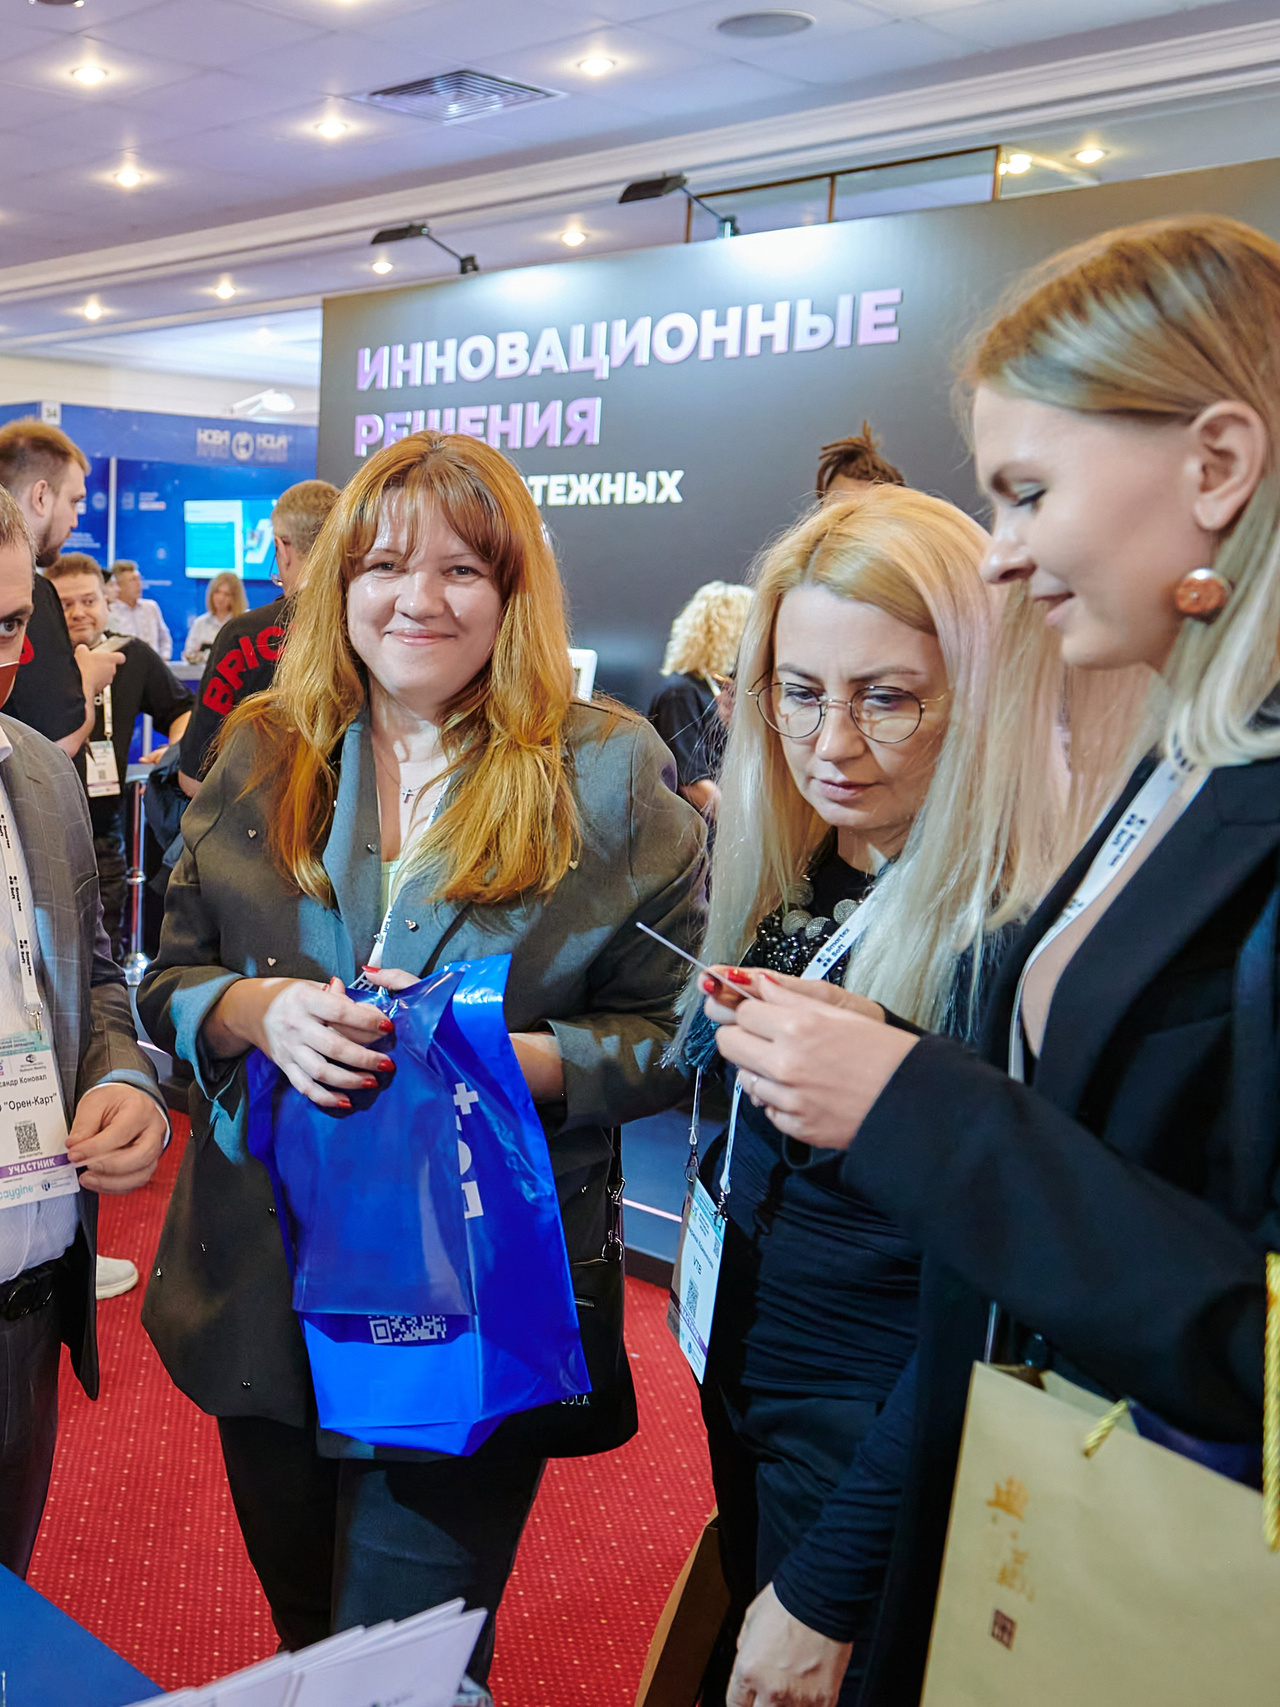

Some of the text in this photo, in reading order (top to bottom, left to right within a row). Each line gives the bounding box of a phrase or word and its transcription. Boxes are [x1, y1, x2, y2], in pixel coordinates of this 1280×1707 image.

[356, 288, 904, 392] ИННОВАЦИОННЫЕ
[520, 469, 685, 507] ТЕЖНЫХ
[202, 625, 292, 717] BRIC
[4, 1092, 58, 1112] "Орен-Карт"
[8, 1157, 56, 1176] УЧАСТНИК
